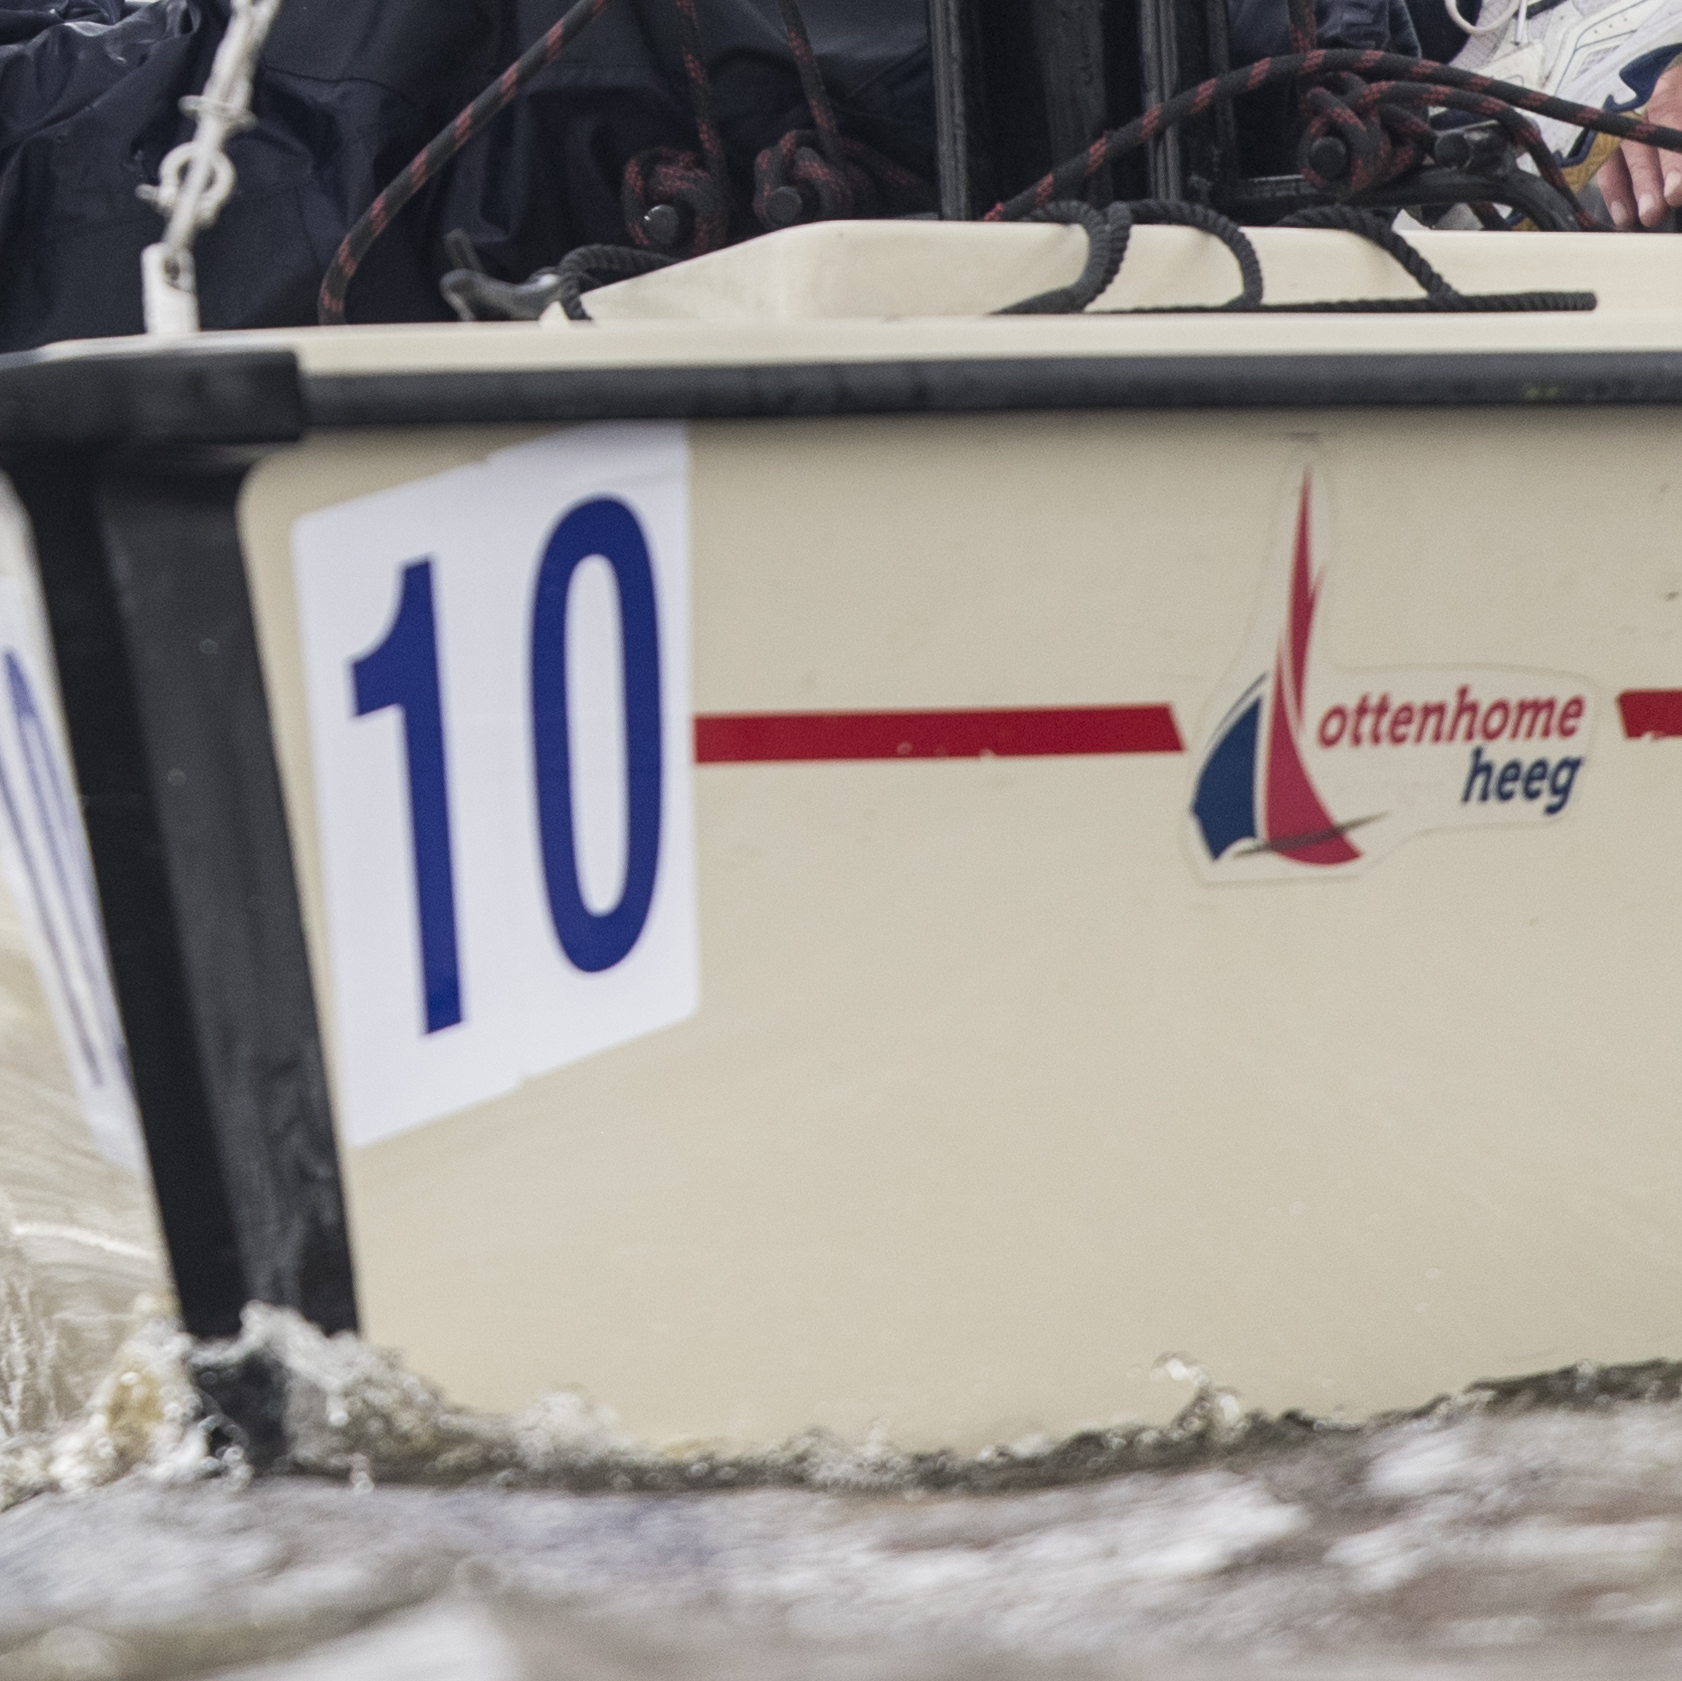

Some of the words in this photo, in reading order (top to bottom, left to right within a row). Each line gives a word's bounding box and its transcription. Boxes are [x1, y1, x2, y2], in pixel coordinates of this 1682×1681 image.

[1318, 684, 1586, 750] ottenhome
[351, 491, 661, 1035] 10
[1461, 745, 1584, 816] heeg
